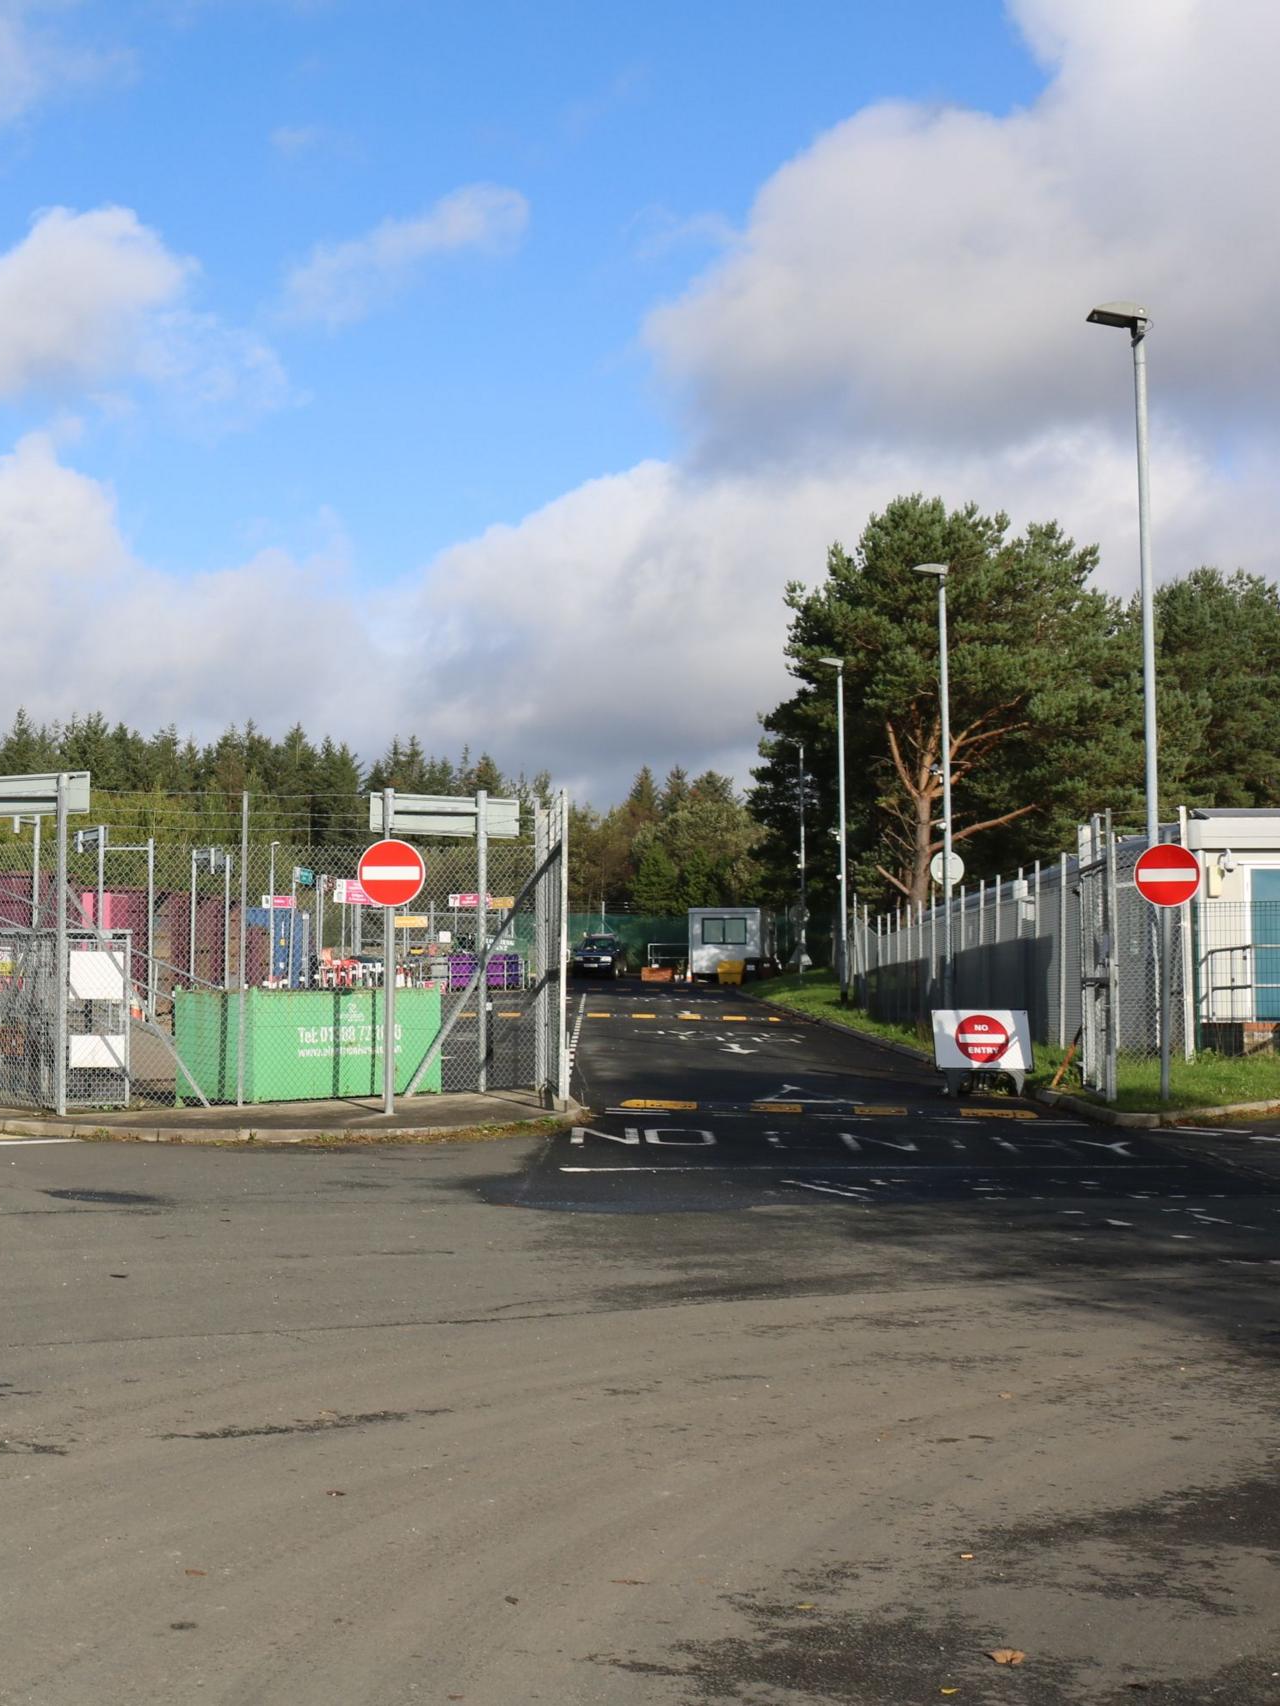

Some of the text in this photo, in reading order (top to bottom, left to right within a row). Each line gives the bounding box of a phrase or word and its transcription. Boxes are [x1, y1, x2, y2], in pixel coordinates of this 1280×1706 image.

[973, 1024, 989, 1032] NO
[968, 1046, 999, 1054] ENTRY
[569, 1127, 718, 1147] NO
